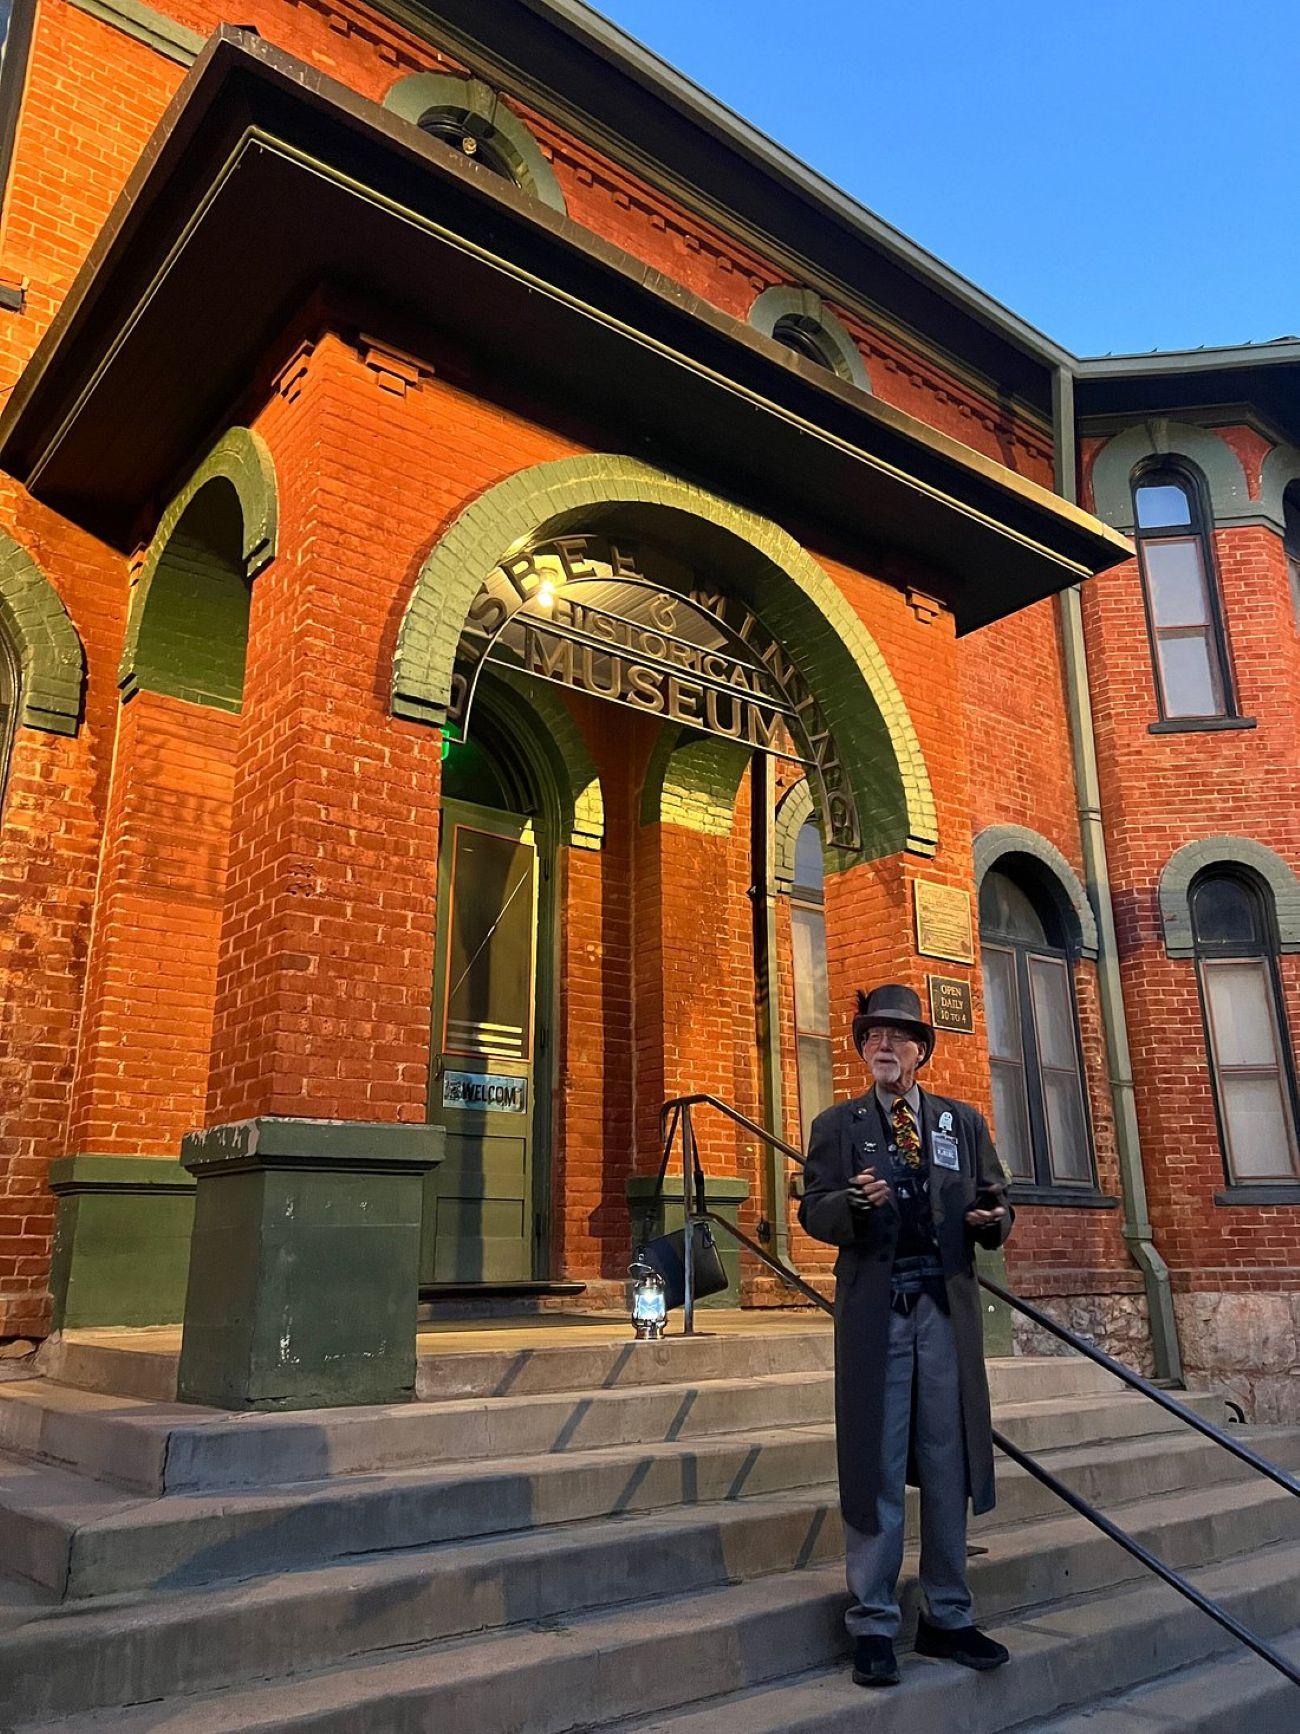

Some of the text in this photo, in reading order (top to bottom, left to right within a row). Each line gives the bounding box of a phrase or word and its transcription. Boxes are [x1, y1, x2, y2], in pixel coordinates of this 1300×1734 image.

[650, 594, 679, 633] &
[552, 597, 772, 698] HISTORICAL
[523, 625, 785, 750] MUSEUM
[941, 985, 961, 996] OPEN
[941, 996, 963, 1009] DAILY
[941, 1009, 950, 1021] 10
[950, 1013, 960, 1022] TO
